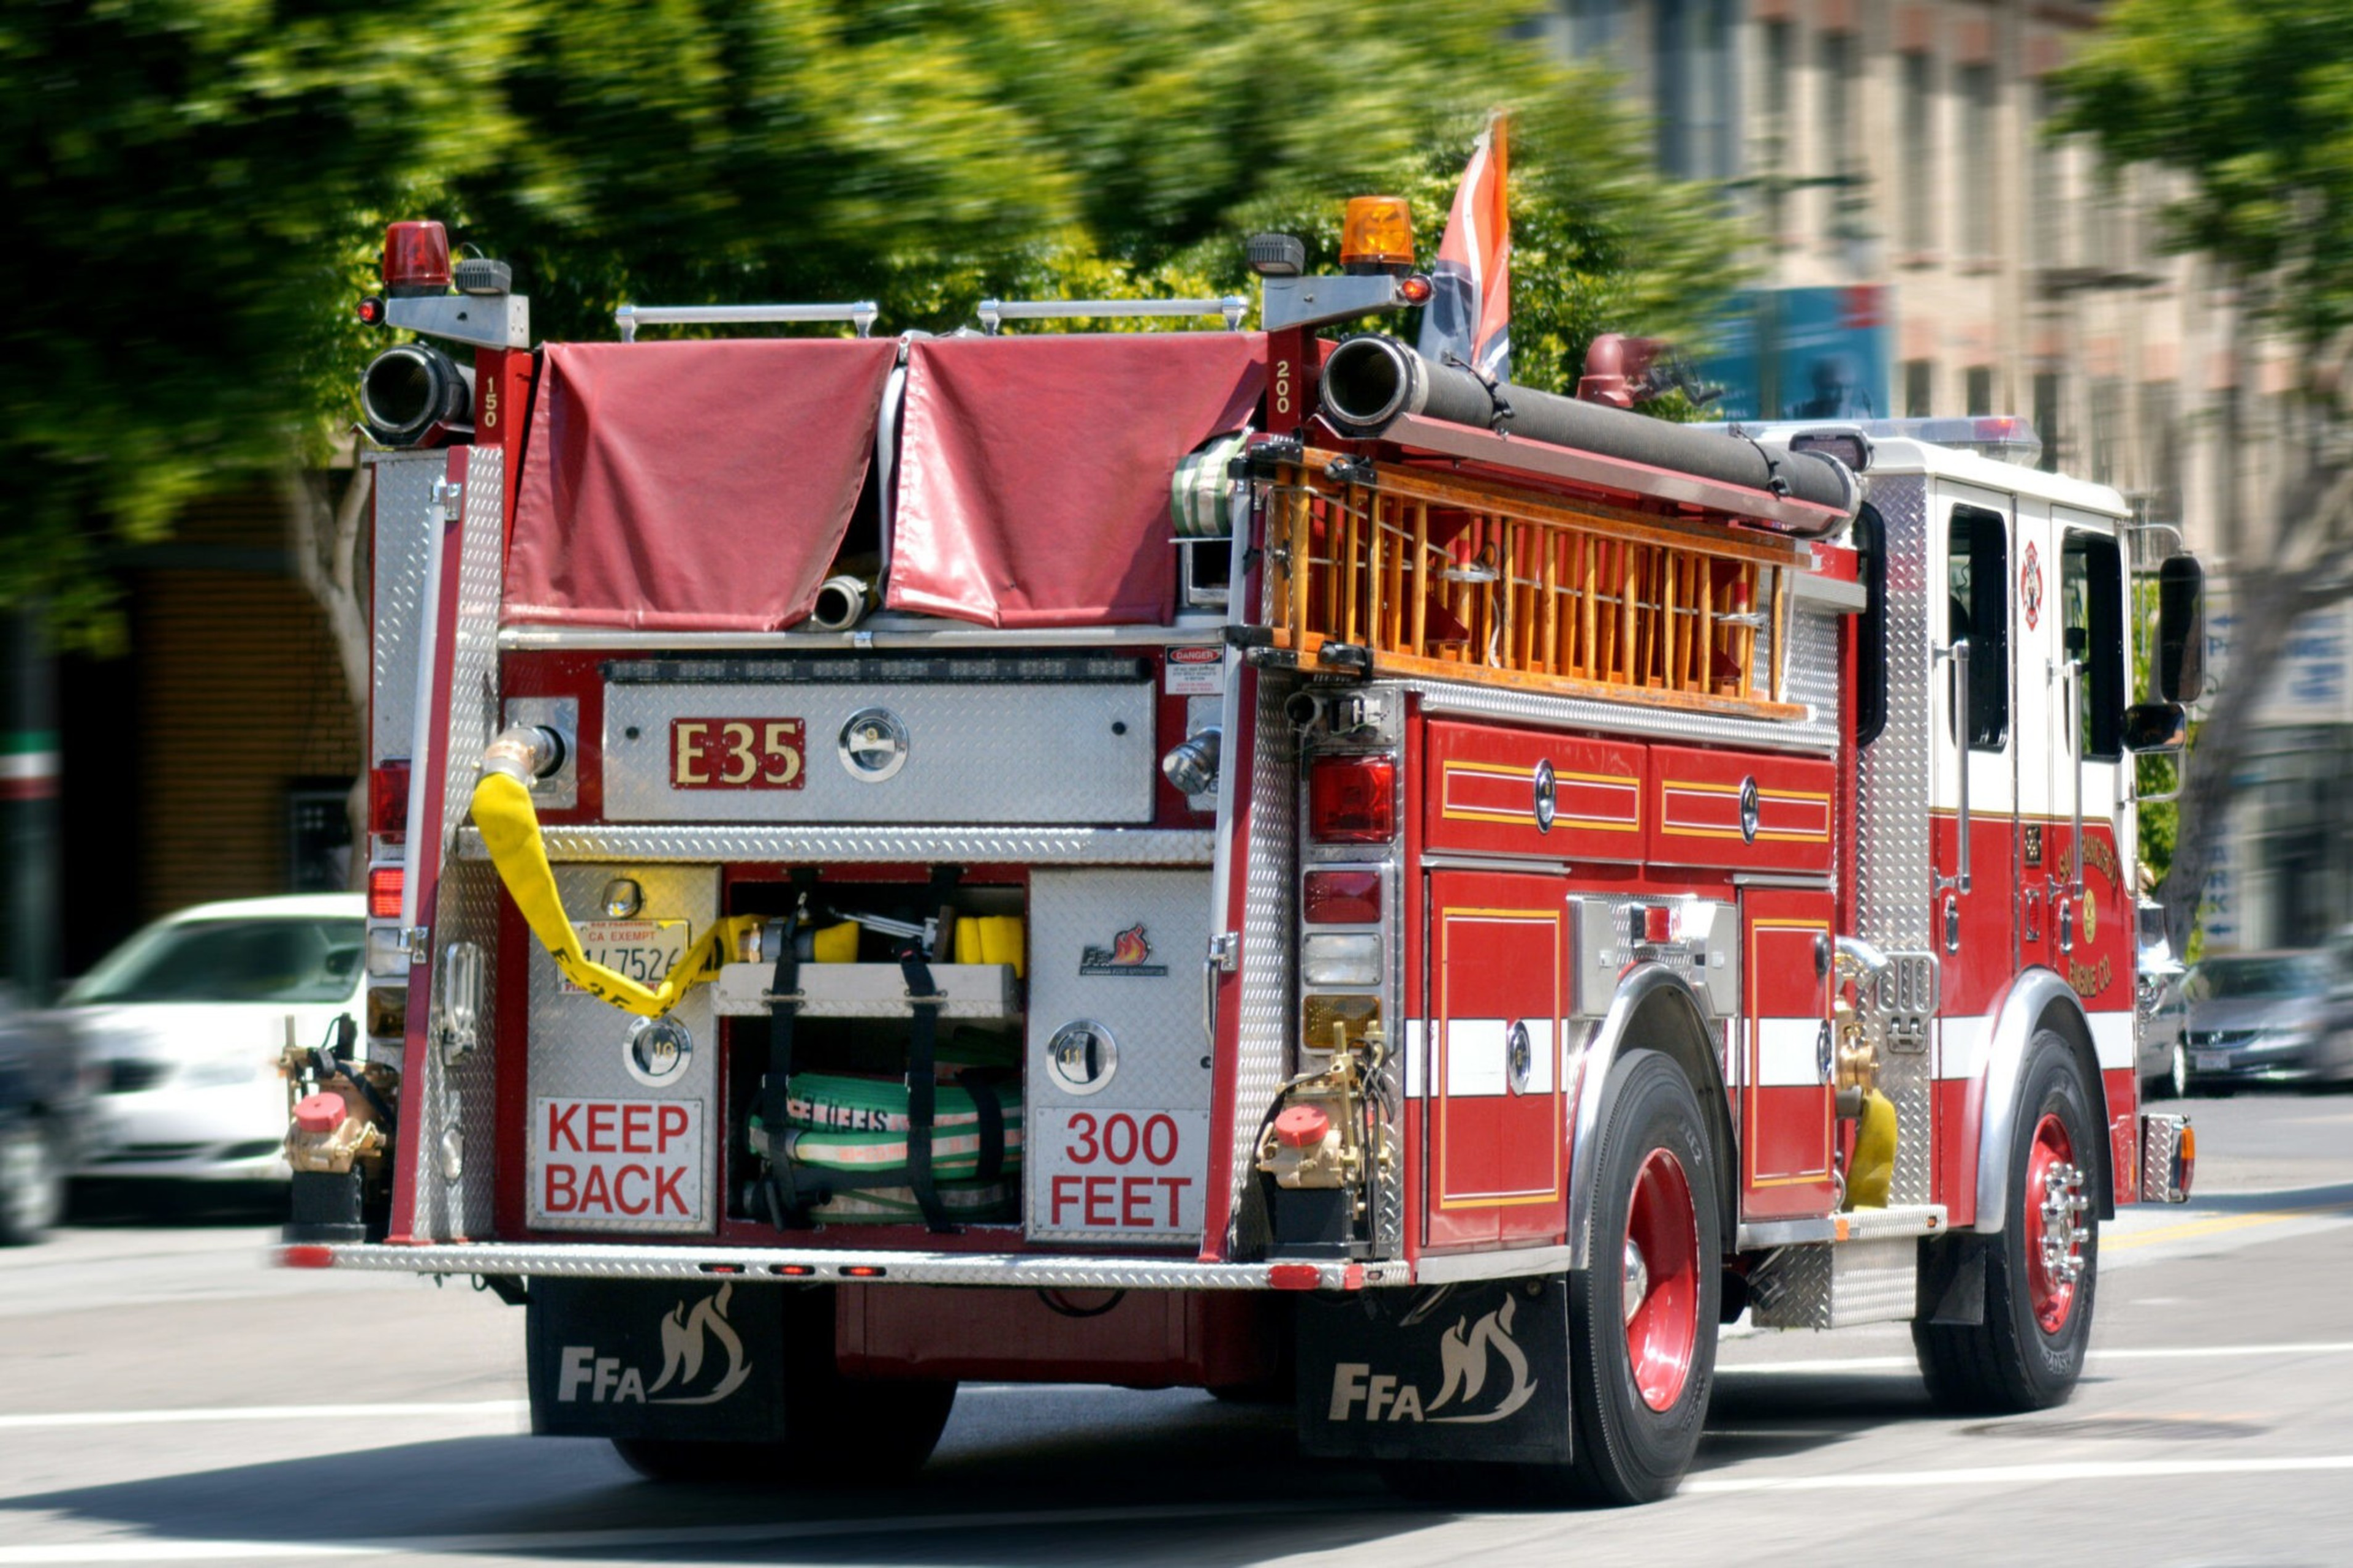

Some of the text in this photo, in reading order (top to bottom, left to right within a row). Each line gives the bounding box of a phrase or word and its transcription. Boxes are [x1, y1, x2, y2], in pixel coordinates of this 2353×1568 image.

[485, 376, 497, 427] 150
[1276, 360, 1290, 414] 200
[1175, 651, 1213, 660] DANGER
[676, 722, 800, 784] E35
[865, 727, 879, 744] 9
[589, 931, 656, 942] CA EXEMPT
[656, 1042, 675, 1058] 10
[1064, 1048, 1082, 1066] 11
[549, 1103, 689, 1154] KEEP
[1066, 1112, 1179, 1166] 300
[545, 1164, 689, 1216] BACK
[1051, 1175, 1192, 1227] FEET
[558, 1346, 646, 1404] FFA
[1328, 1363, 1424, 1422] FFA
